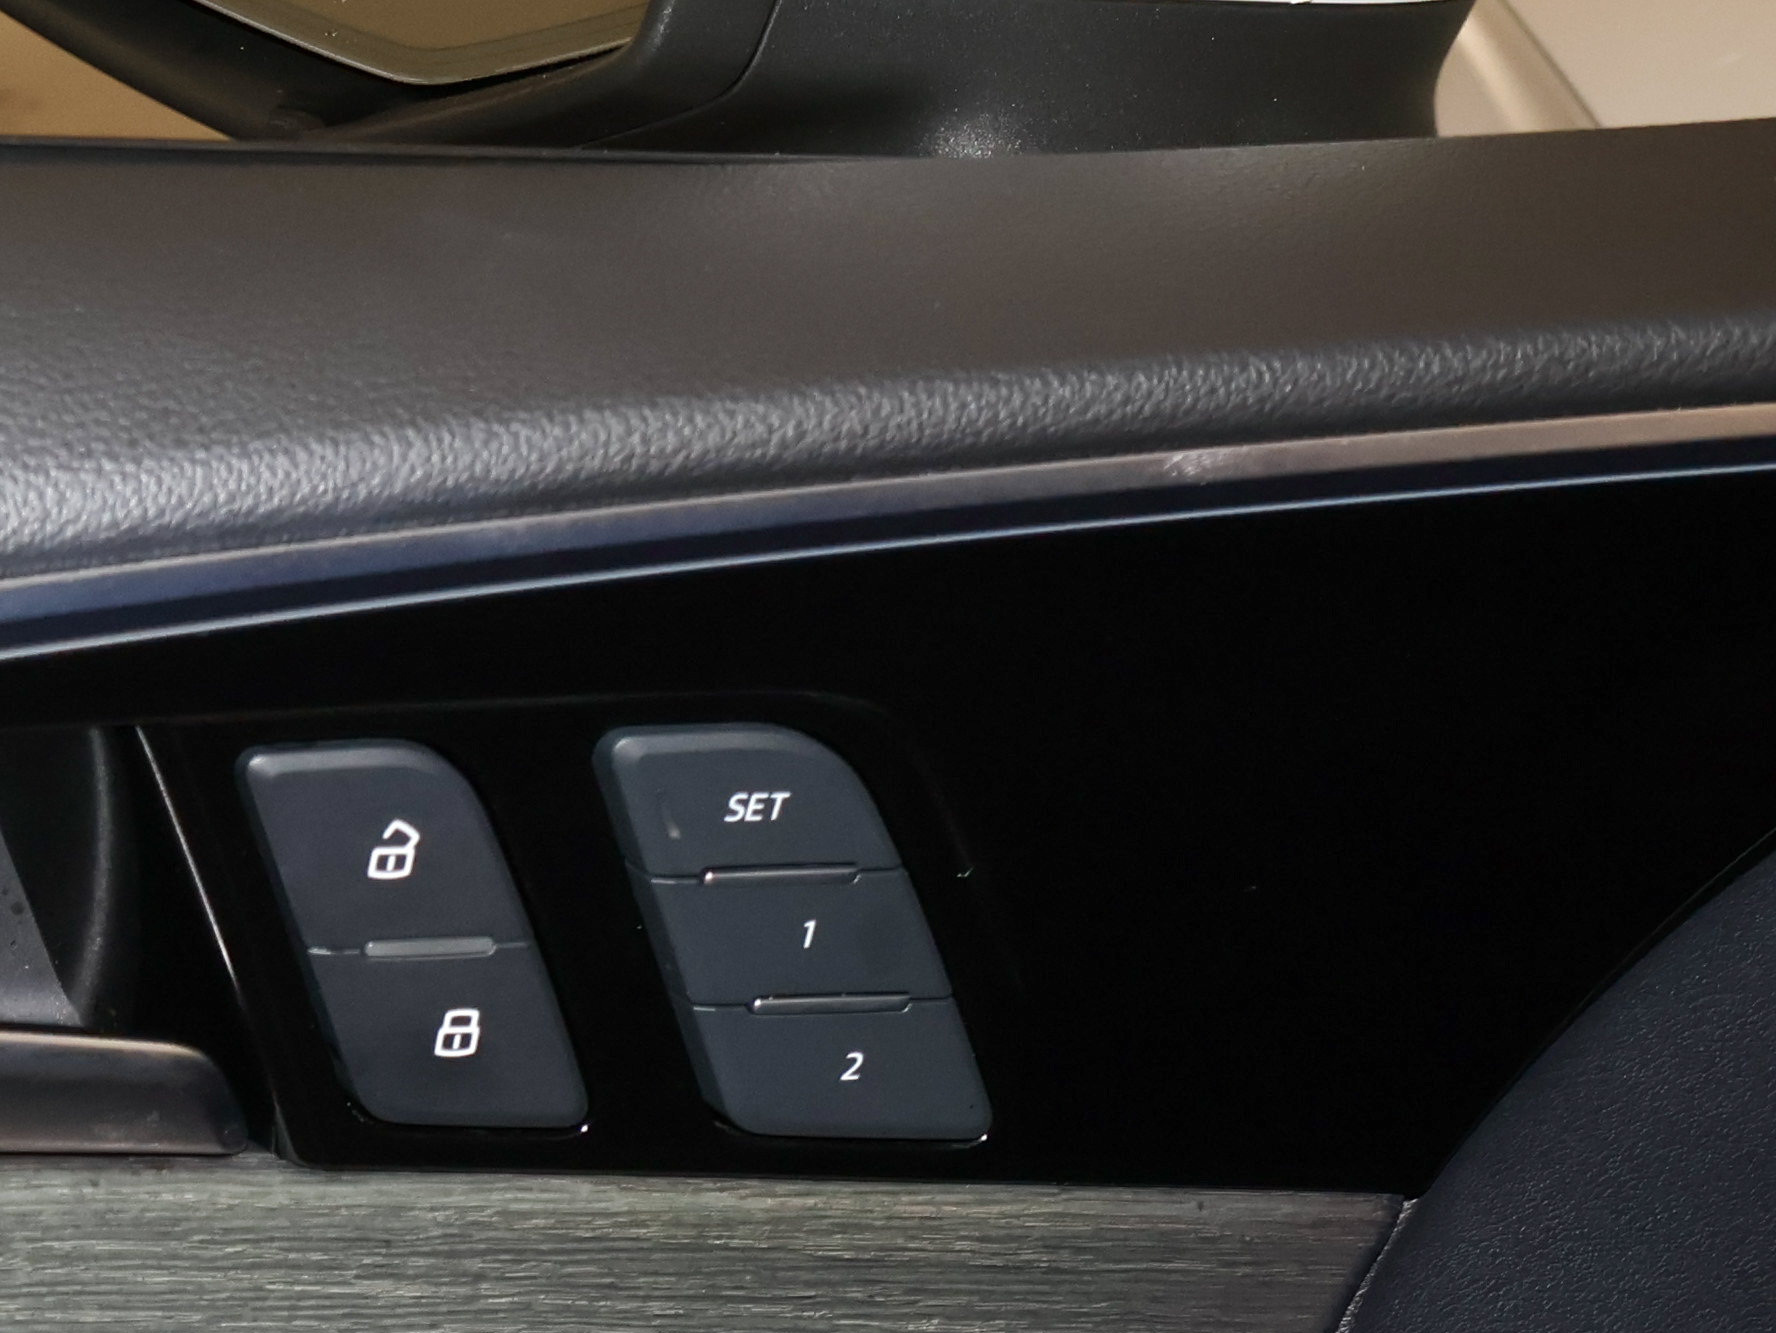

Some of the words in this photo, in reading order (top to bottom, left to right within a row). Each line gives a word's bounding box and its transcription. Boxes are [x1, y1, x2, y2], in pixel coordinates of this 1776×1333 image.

[723, 791, 792, 823] SET
[802, 919, 818, 950] 1
[839, 1051, 865, 1082] 2
